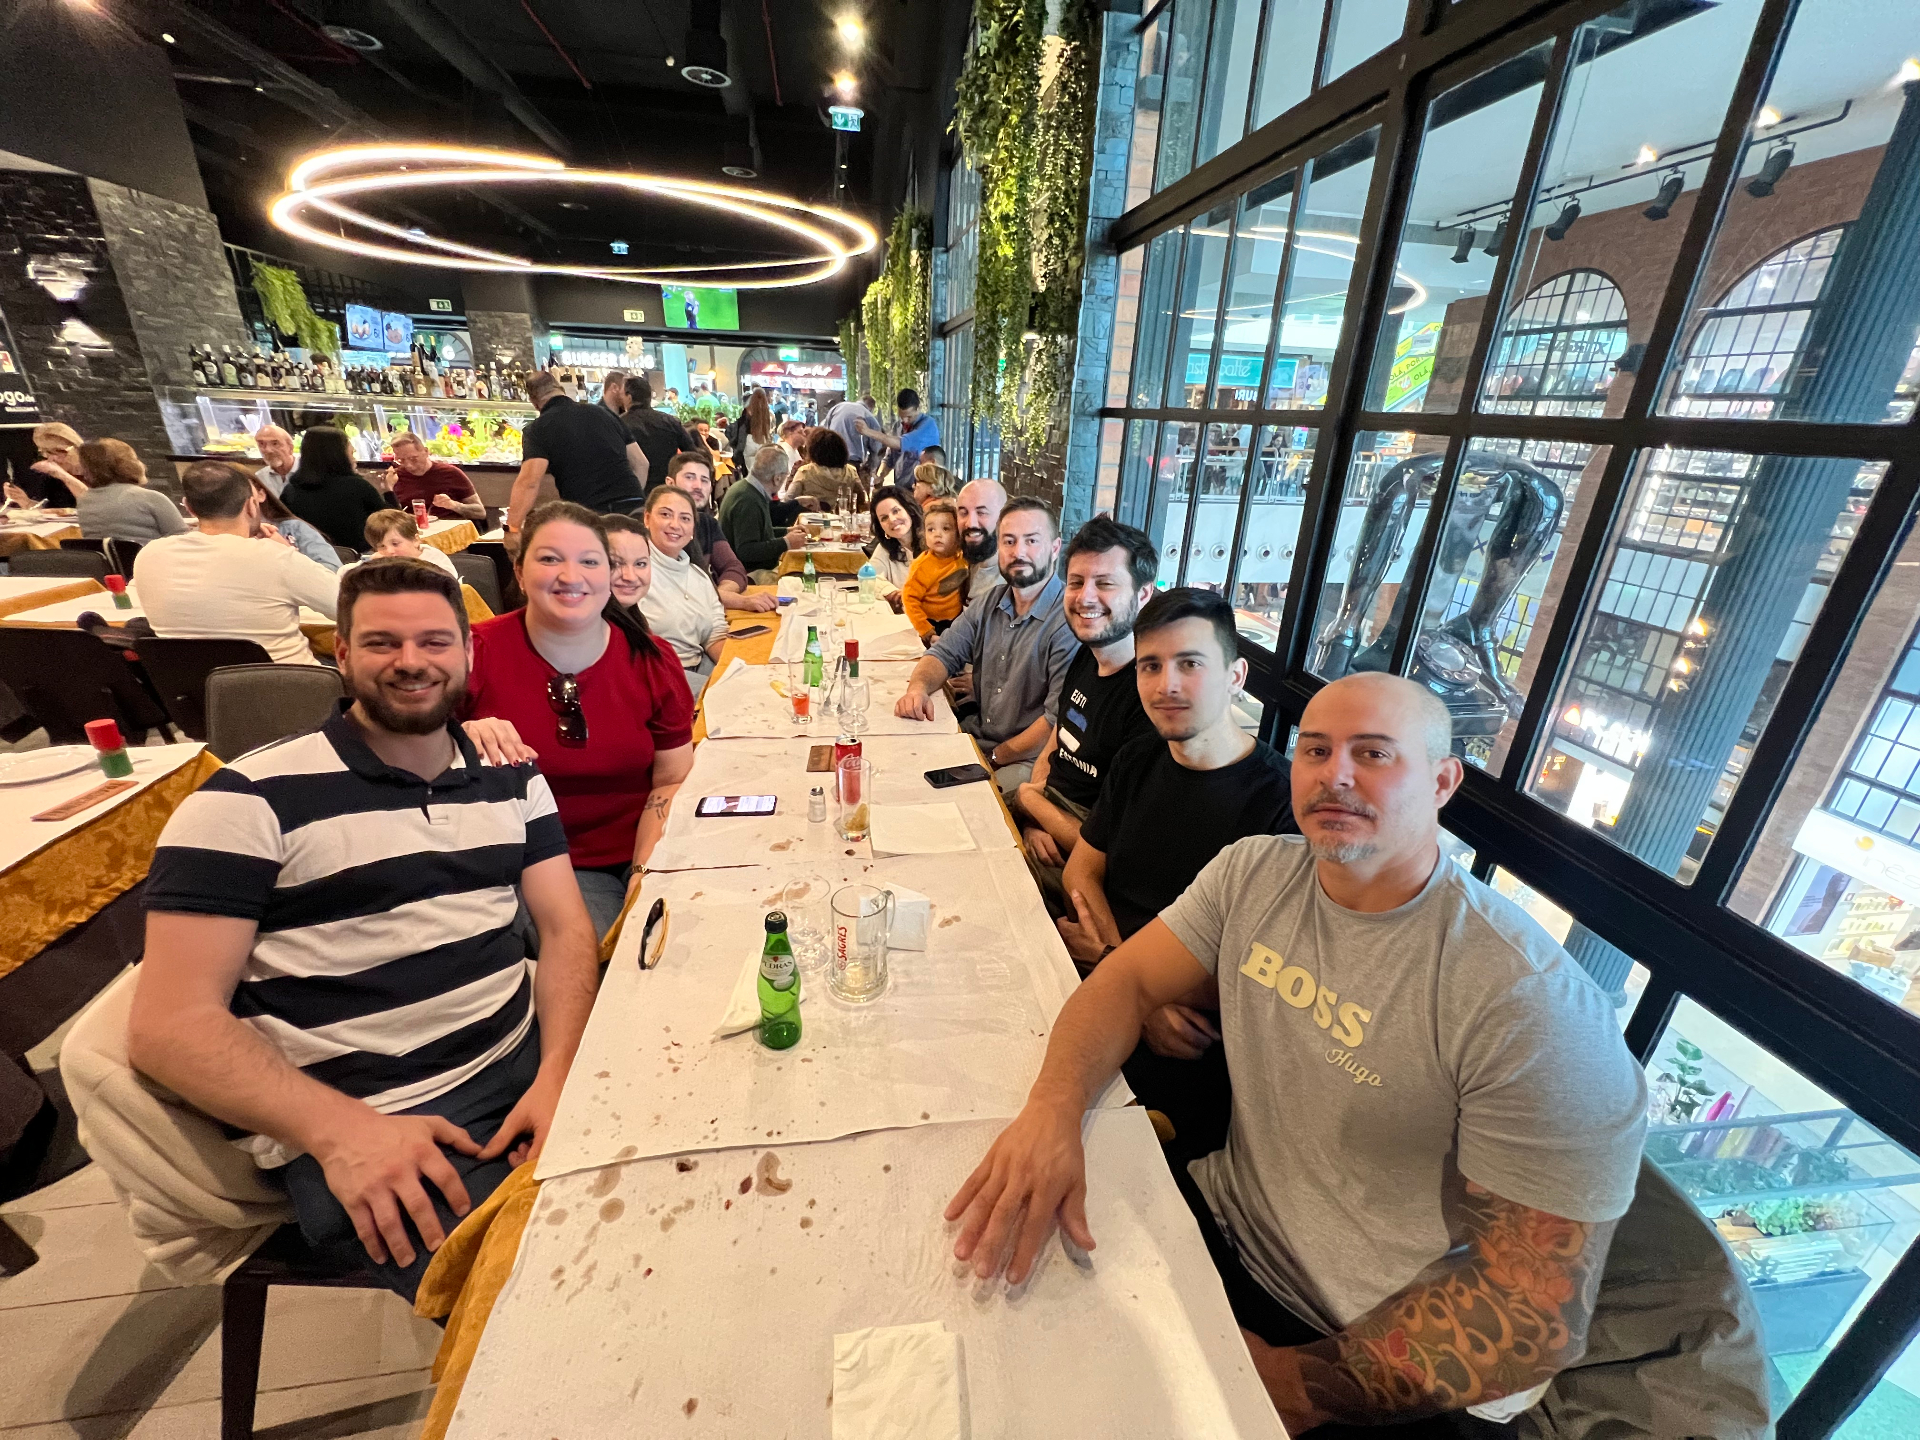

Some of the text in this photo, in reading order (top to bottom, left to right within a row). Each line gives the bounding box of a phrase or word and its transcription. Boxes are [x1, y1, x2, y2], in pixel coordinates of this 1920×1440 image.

[562, 350, 618, 367] BURGER
[837, 924, 848, 962] SAGRES
[1239, 941, 1373, 1048] BOSS
[1325, 1049, 1384, 1087] Hugo
